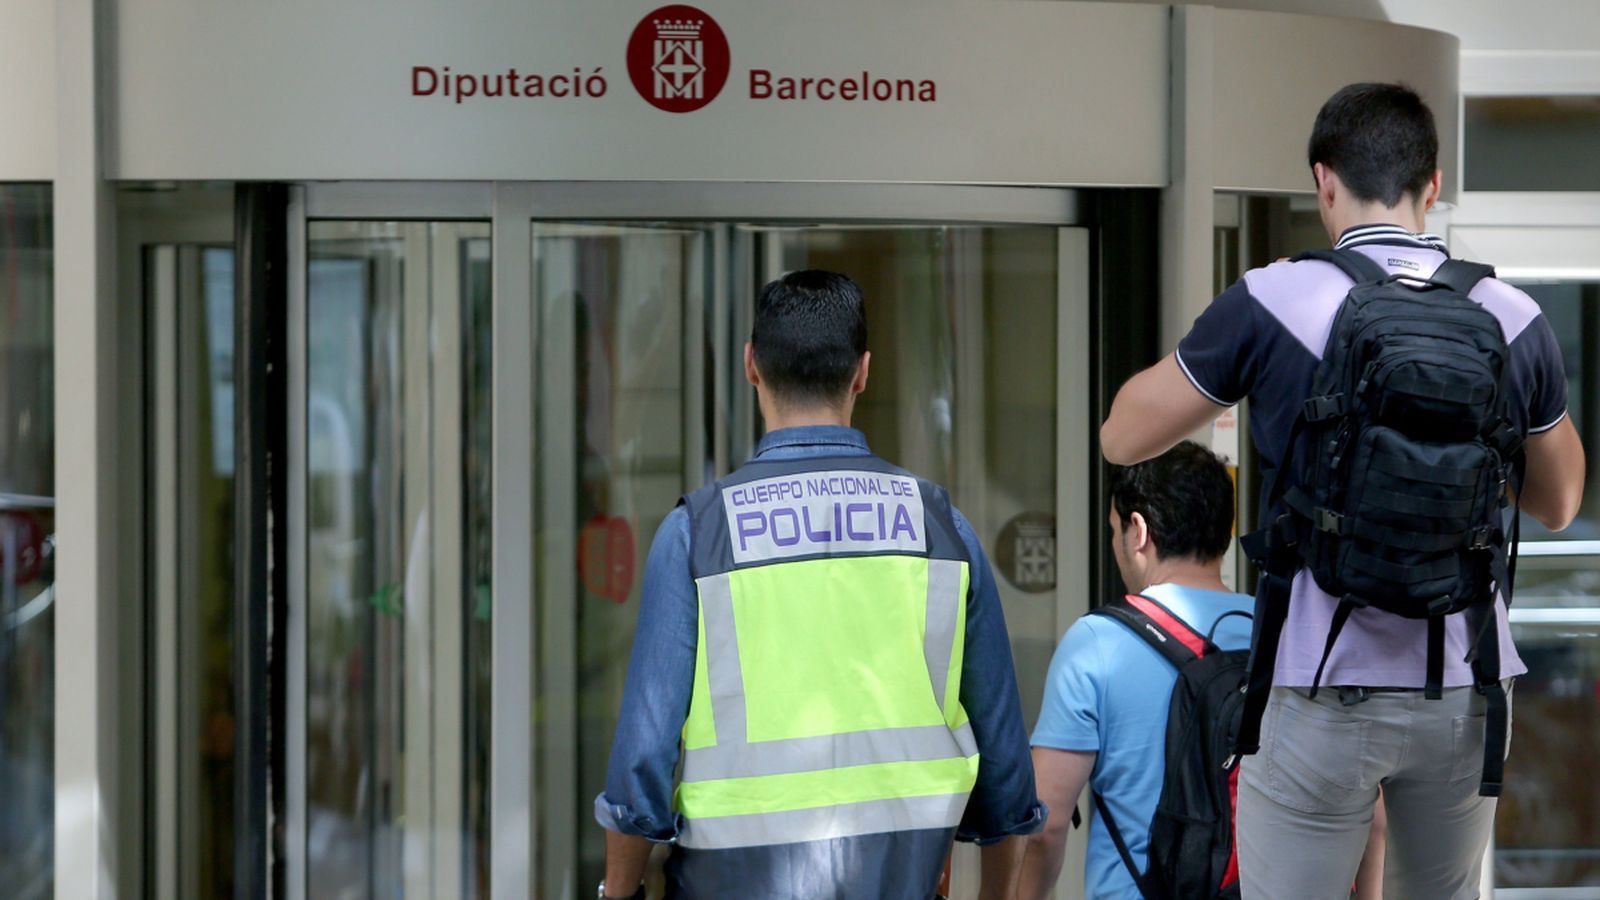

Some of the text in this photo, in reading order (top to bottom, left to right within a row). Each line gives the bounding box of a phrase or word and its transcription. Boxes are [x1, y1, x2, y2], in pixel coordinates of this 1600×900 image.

[411, 66, 937, 104] Diputació Barcelona
[732, 477, 914, 506] CUERPO NACIONAL DE
[736, 502, 917, 551] POLICIA
